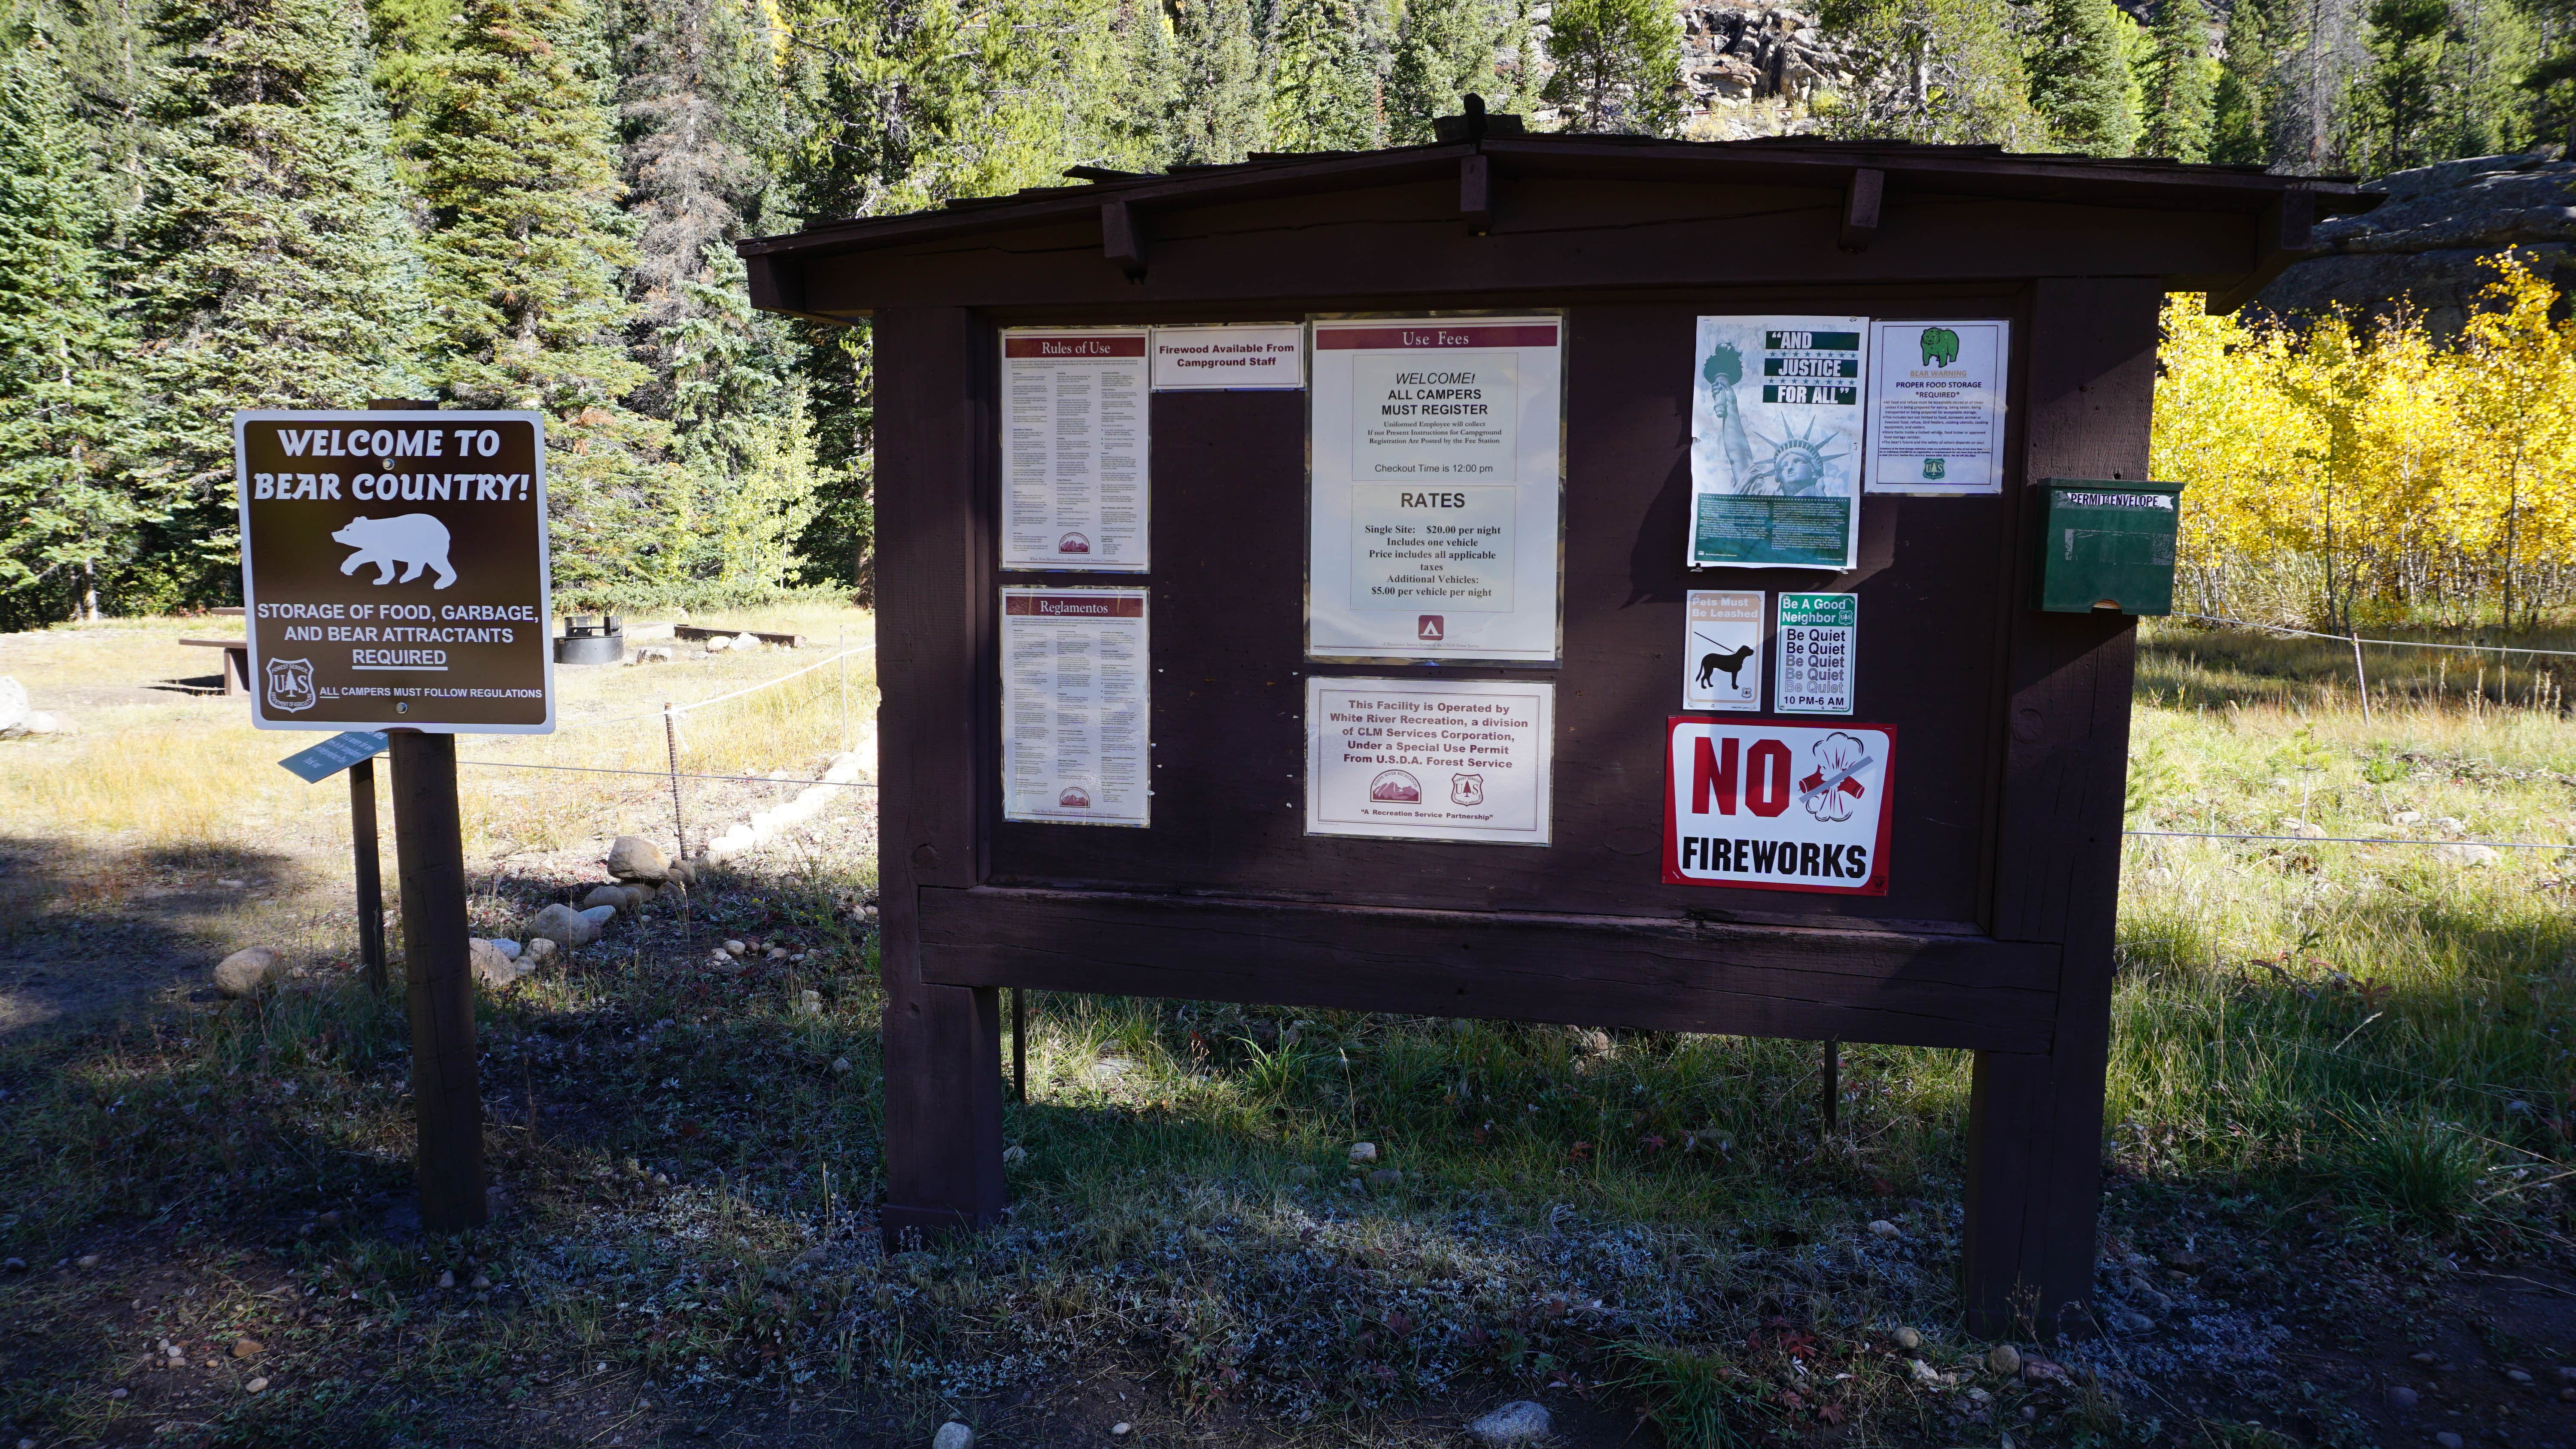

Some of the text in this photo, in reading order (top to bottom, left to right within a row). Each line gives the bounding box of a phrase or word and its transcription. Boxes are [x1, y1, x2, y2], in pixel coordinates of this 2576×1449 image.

[1403, 331, 1469, 345] Use Fees
[1042, 342, 1111, 354] Rules of Use
[1159, 344, 1294, 354] Firewood Available From
[1177, 357, 1276, 369] Campground Staff
[1778, 360, 1841, 377] JUSTICE
[1396, 373, 1475, 385] WELCOME!
[1388, 389, 1482, 400] ALL CAMPERS
[1777, 386, 1849, 404] FOR ALL”
[1382, 404, 1488, 415] MUST REGISTER
[276, 430, 500, 457] WELCOME TO
[1479, 466, 1493, 474] pm
[254, 473, 529, 500] BEAR COUNTRY!
[1401, 493, 1465, 508] RATES
[2071, 494, 2158, 507] PERMIT ENVELOPE
[1365, 525, 1501, 537] Single Site: $20.00 per night
[1387, 538, 1425, 546] Includes
[1446, 538, 1478, 546] vehicle
[1369, 550, 1392, 558] Price
[1395, 550, 1432, 558] includes
[1449, 551, 1496, 561] applicable
[1387, 575, 1479, 584] Additional Vehicles:
[1371, 586, 1492, 598] $5.00 per vehicle per night
[1040, 600, 1108, 615] Reglamentos
[1692, 597, 1748, 607] Pets Must
[1783, 598, 1846, 610] Be A Good
[258, 603, 538, 623] STORAGE OF FOOD, GARBAGE,
[1692, 609, 1758, 618] Be Leashed
[1782, 611, 1836, 624] Neighbor
[284, 626, 513, 643] AND BEAR ATTRACTANTS
[1787, 629, 1846, 642] Be Quiet
[1787, 642, 1845, 655] Be Quiet
[352, 649, 446, 665] REQUIRED
[1786, 655, 1845, 668] Be Quiet
[272, 664, 308, 674] FOREST SERVICE
[1786, 668, 1844, 681] Be Quiet
[319, 687, 543, 698] ALL CAMPERS MUST FOLLOW REGULATIONS
[1785, 680, 1844, 694] Be Quiet
[1348, 700, 1510, 715] This Facility is Operated by
[1784, 696, 1795, 705] 10
[1827, 697, 1844, 706] AM
[1330, 712, 1363, 722] White
[1367, 714, 1397, 724] River
[1400, 715, 1467, 727] Recreation,
[1482, 718, 1528, 728] division
[1342, 727, 1515, 743] of CLM Services Corporation,
[1348, 740, 1382, 750] Under
[1396, 742, 1439, 755] Special
[1443, 744, 1466, 753] Use
[1470, 745, 1509, 755] Permit
[1344, 753, 1513, 768] From U.S.D.A. Forest Service
[1374, 775, 1384, 786] WHITE
[1397, 772, 1418, 788] RECREATION
[1692, 737, 1792, 818] NO
[1446, 812, 1493, 821] Partnership”
[1683, 836, 1867, 879] FIREWORKS
